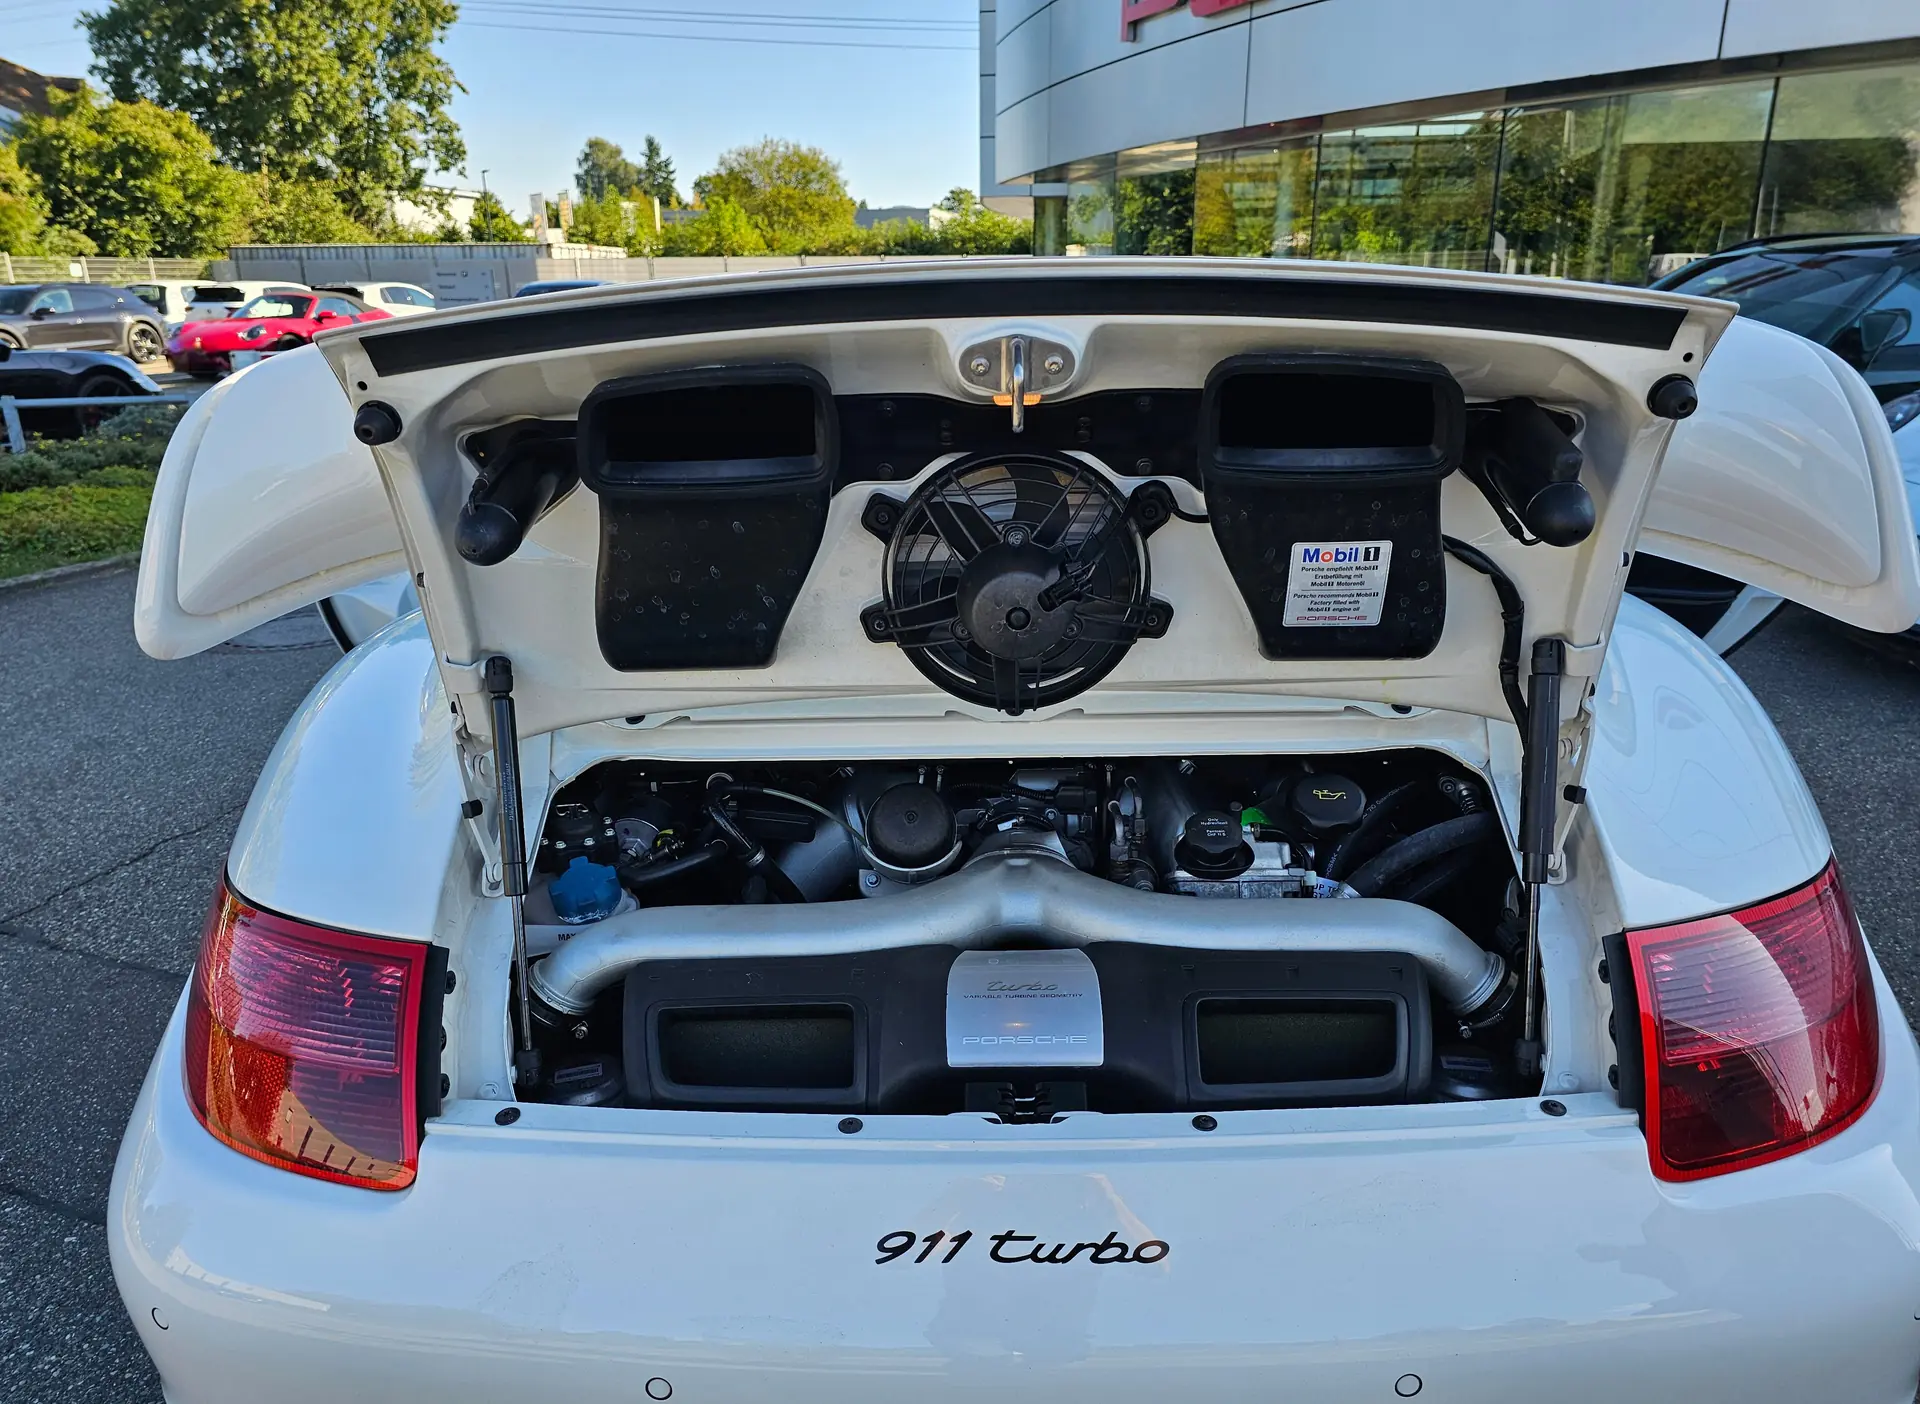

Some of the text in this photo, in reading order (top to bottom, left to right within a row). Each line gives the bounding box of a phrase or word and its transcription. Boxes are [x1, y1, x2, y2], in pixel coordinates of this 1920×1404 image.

[1302, 547, 1359, 563] Mobil
[962, 1035, 1088, 1045] PORSCHE
[874, 1229, 1170, 1265] 911 turbo
